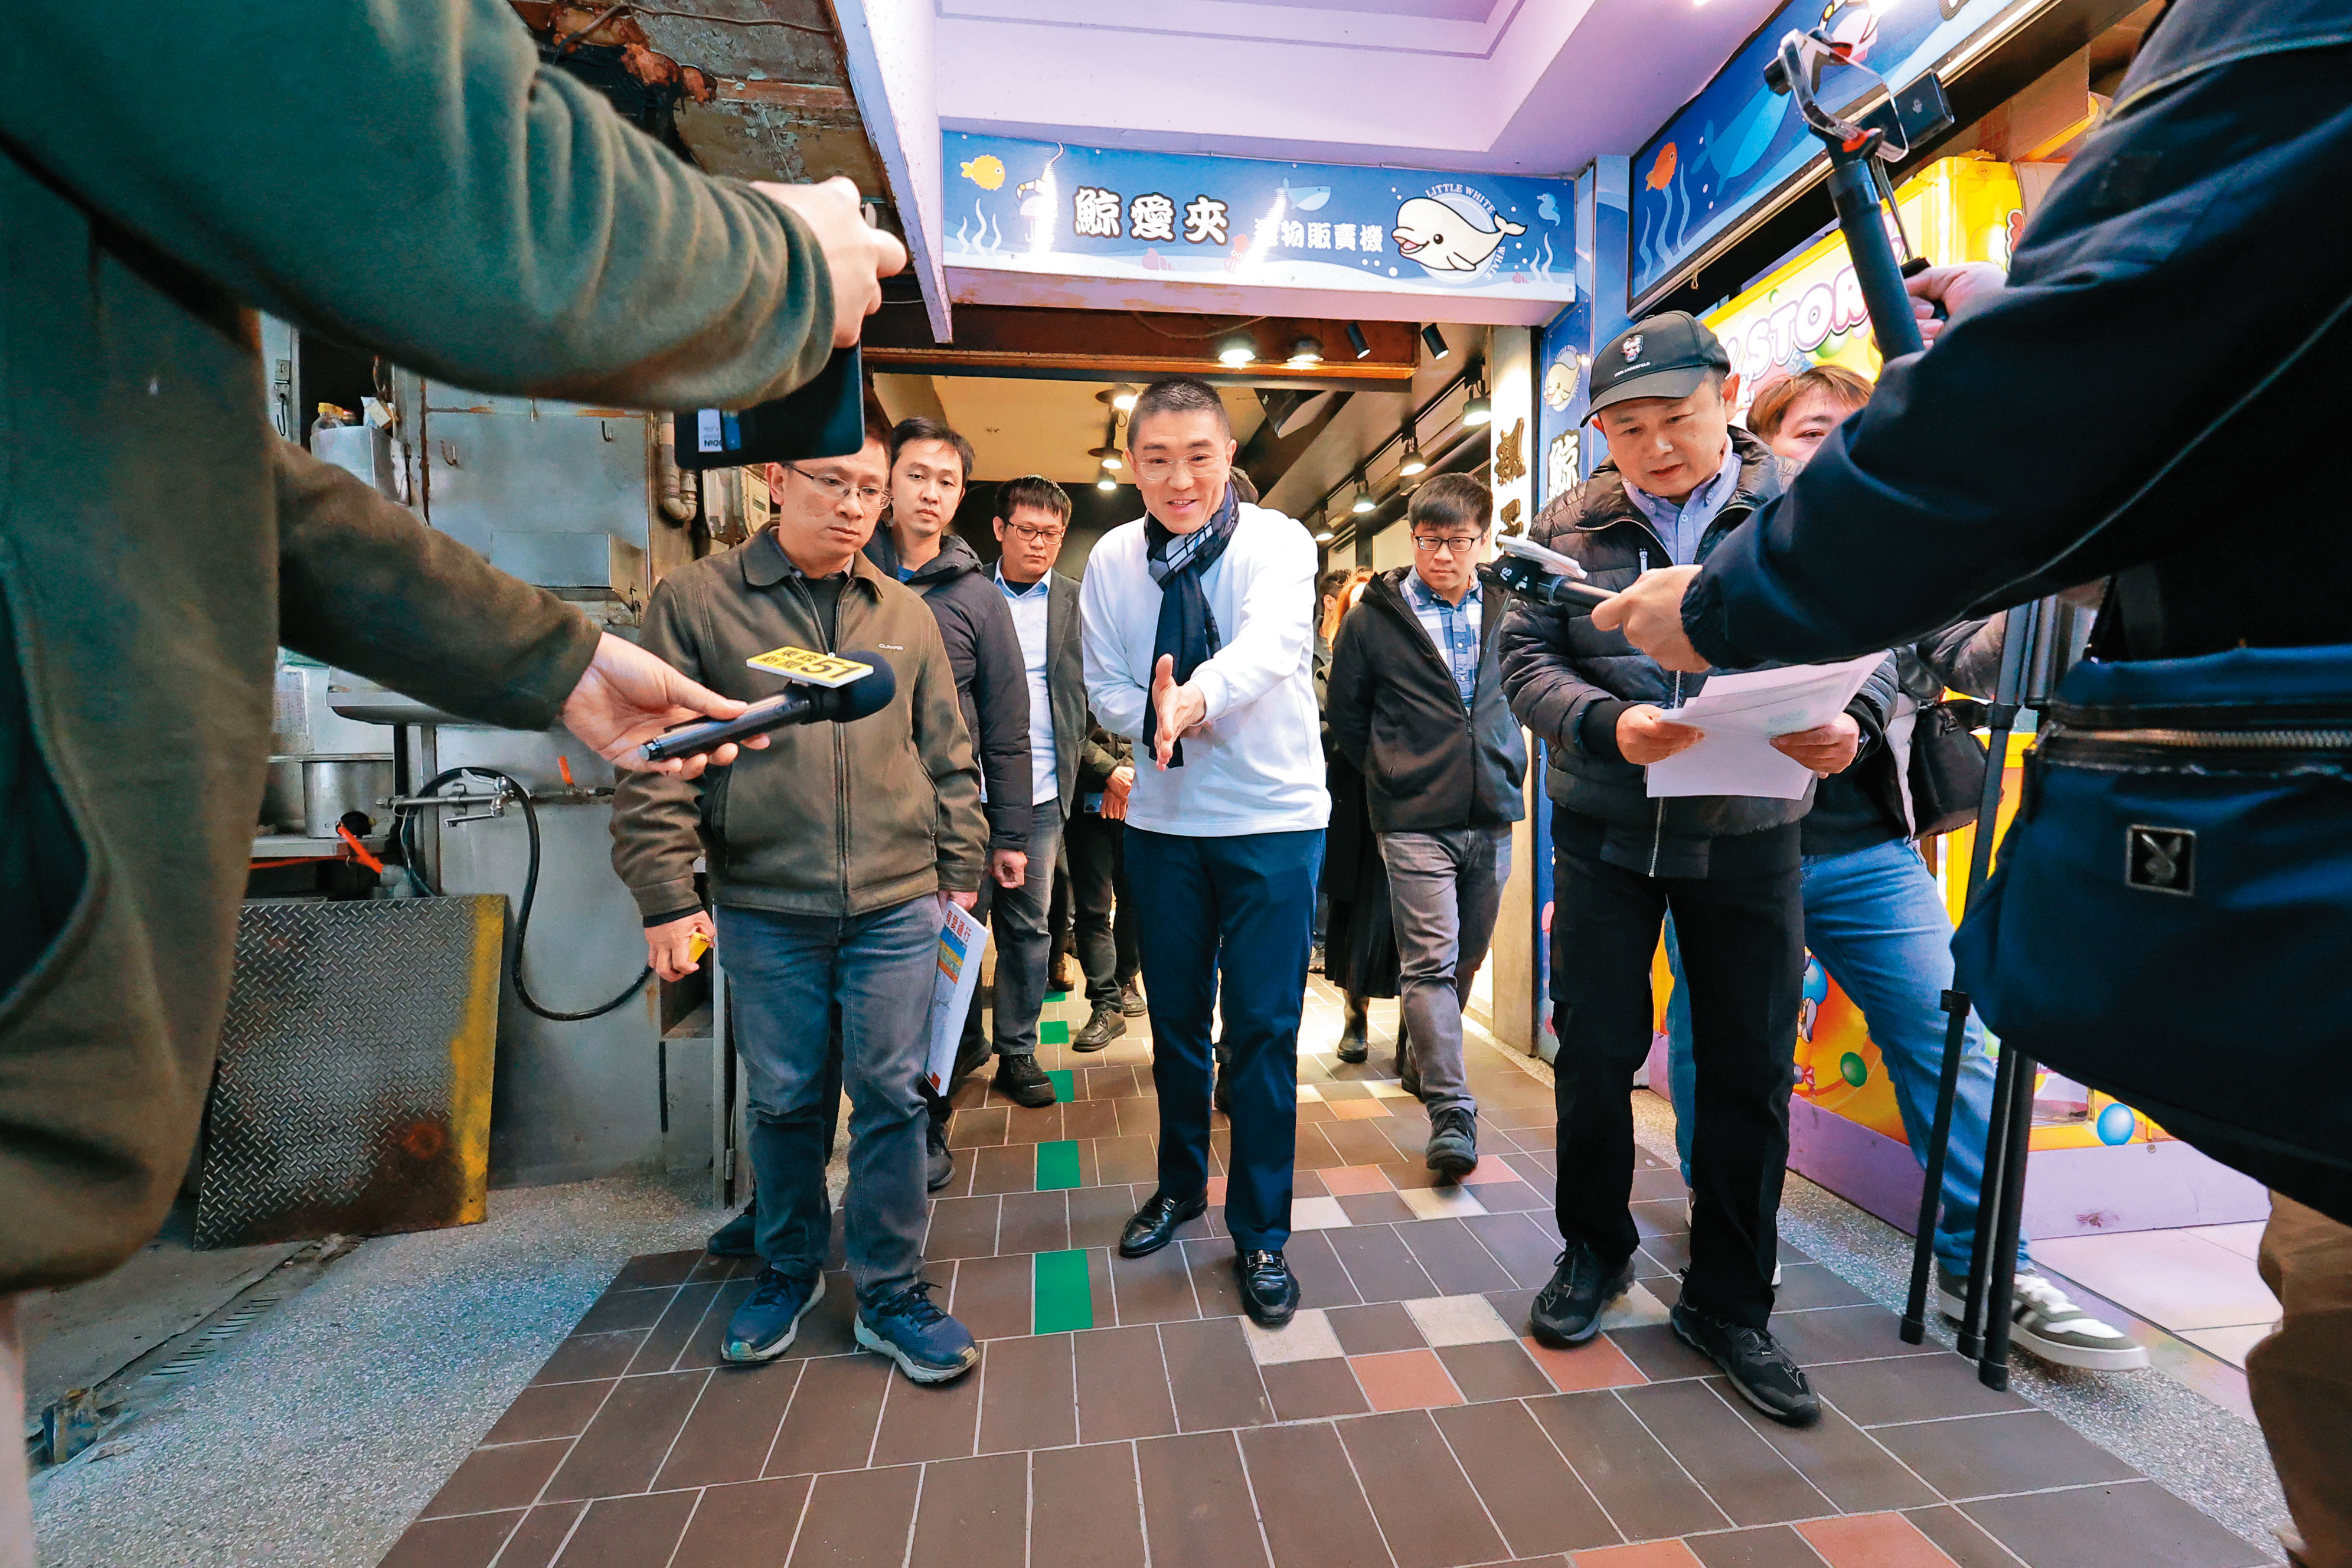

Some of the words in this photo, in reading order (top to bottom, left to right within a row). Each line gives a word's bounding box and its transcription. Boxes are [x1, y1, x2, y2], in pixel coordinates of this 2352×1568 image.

[1425, 183, 1464, 198] LITTLE
[1465, 185, 1496, 214] WHITE
[1073, 187, 1229, 245] 鯨愛夾
[1483, 246, 1506, 281] WHALE
[801, 660, 861, 678] 51
